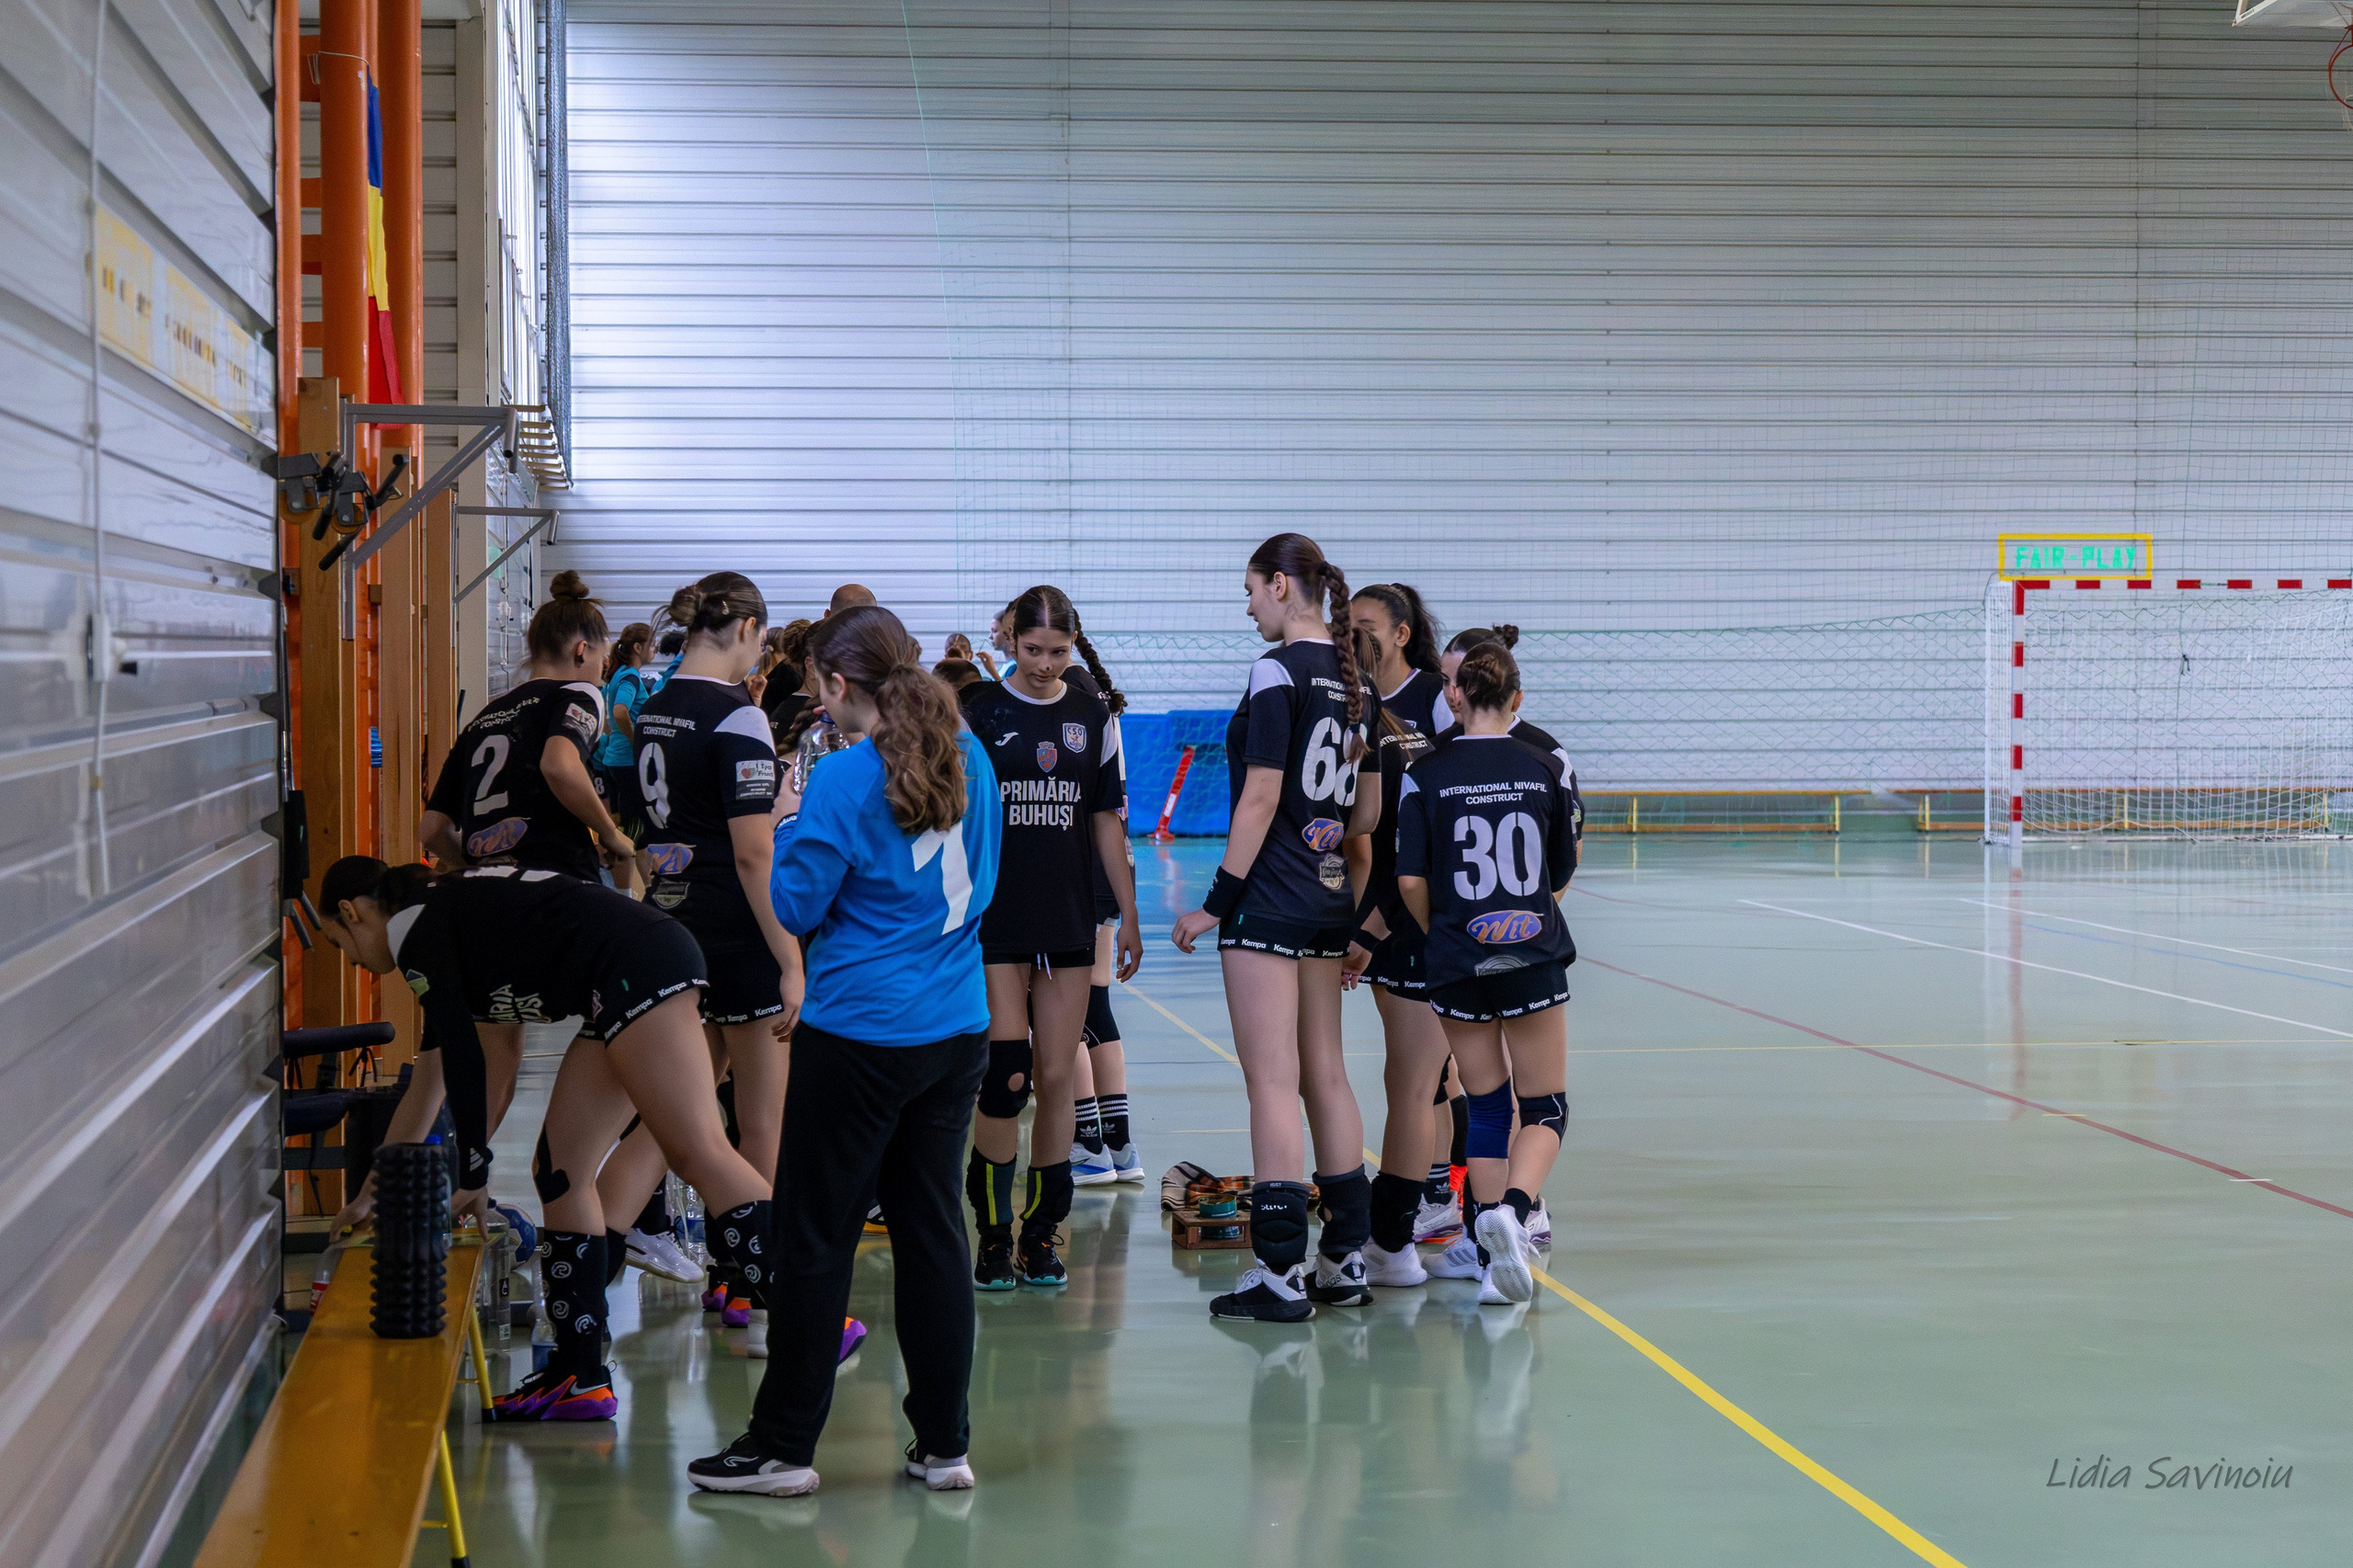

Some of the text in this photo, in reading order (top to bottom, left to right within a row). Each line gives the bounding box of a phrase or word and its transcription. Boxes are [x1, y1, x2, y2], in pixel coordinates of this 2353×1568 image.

[2016, 546, 2136, 569] FAIR-PLAY
[643, 725, 677, 738] CONSTRUCT
[471, 734, 510, 816] 2
[638, 742, 672, 829] 9
[1000, 776, 1081, 802] PRIMĂRIA
[1439, 781, 1547, 798] INTERNATIONAL NIVAFIL
[1465, 793, 1524, 805] CONSTRUCT
[1009, 804, 1074, 832] BUHUȘI
[1453, 812, 1542, 901] 30
[911, 819, 973, 936] 1
[1471, 911, 1537, 945] Wit
[1241, 938, 1267, 949] Kempa
[1273, 943, 1294, 956] Kempa
[657, 982, 688, 998] Kempa
[625, 998, 654, 1019] Kempa
[754, 1004, 782, 1017] Kempa
[1502, 1007, 1524, 1017] Kempa
[1529, 997, 1551, 1010] Kempa
[1450, 1008, 1475, 1020] Kempa
